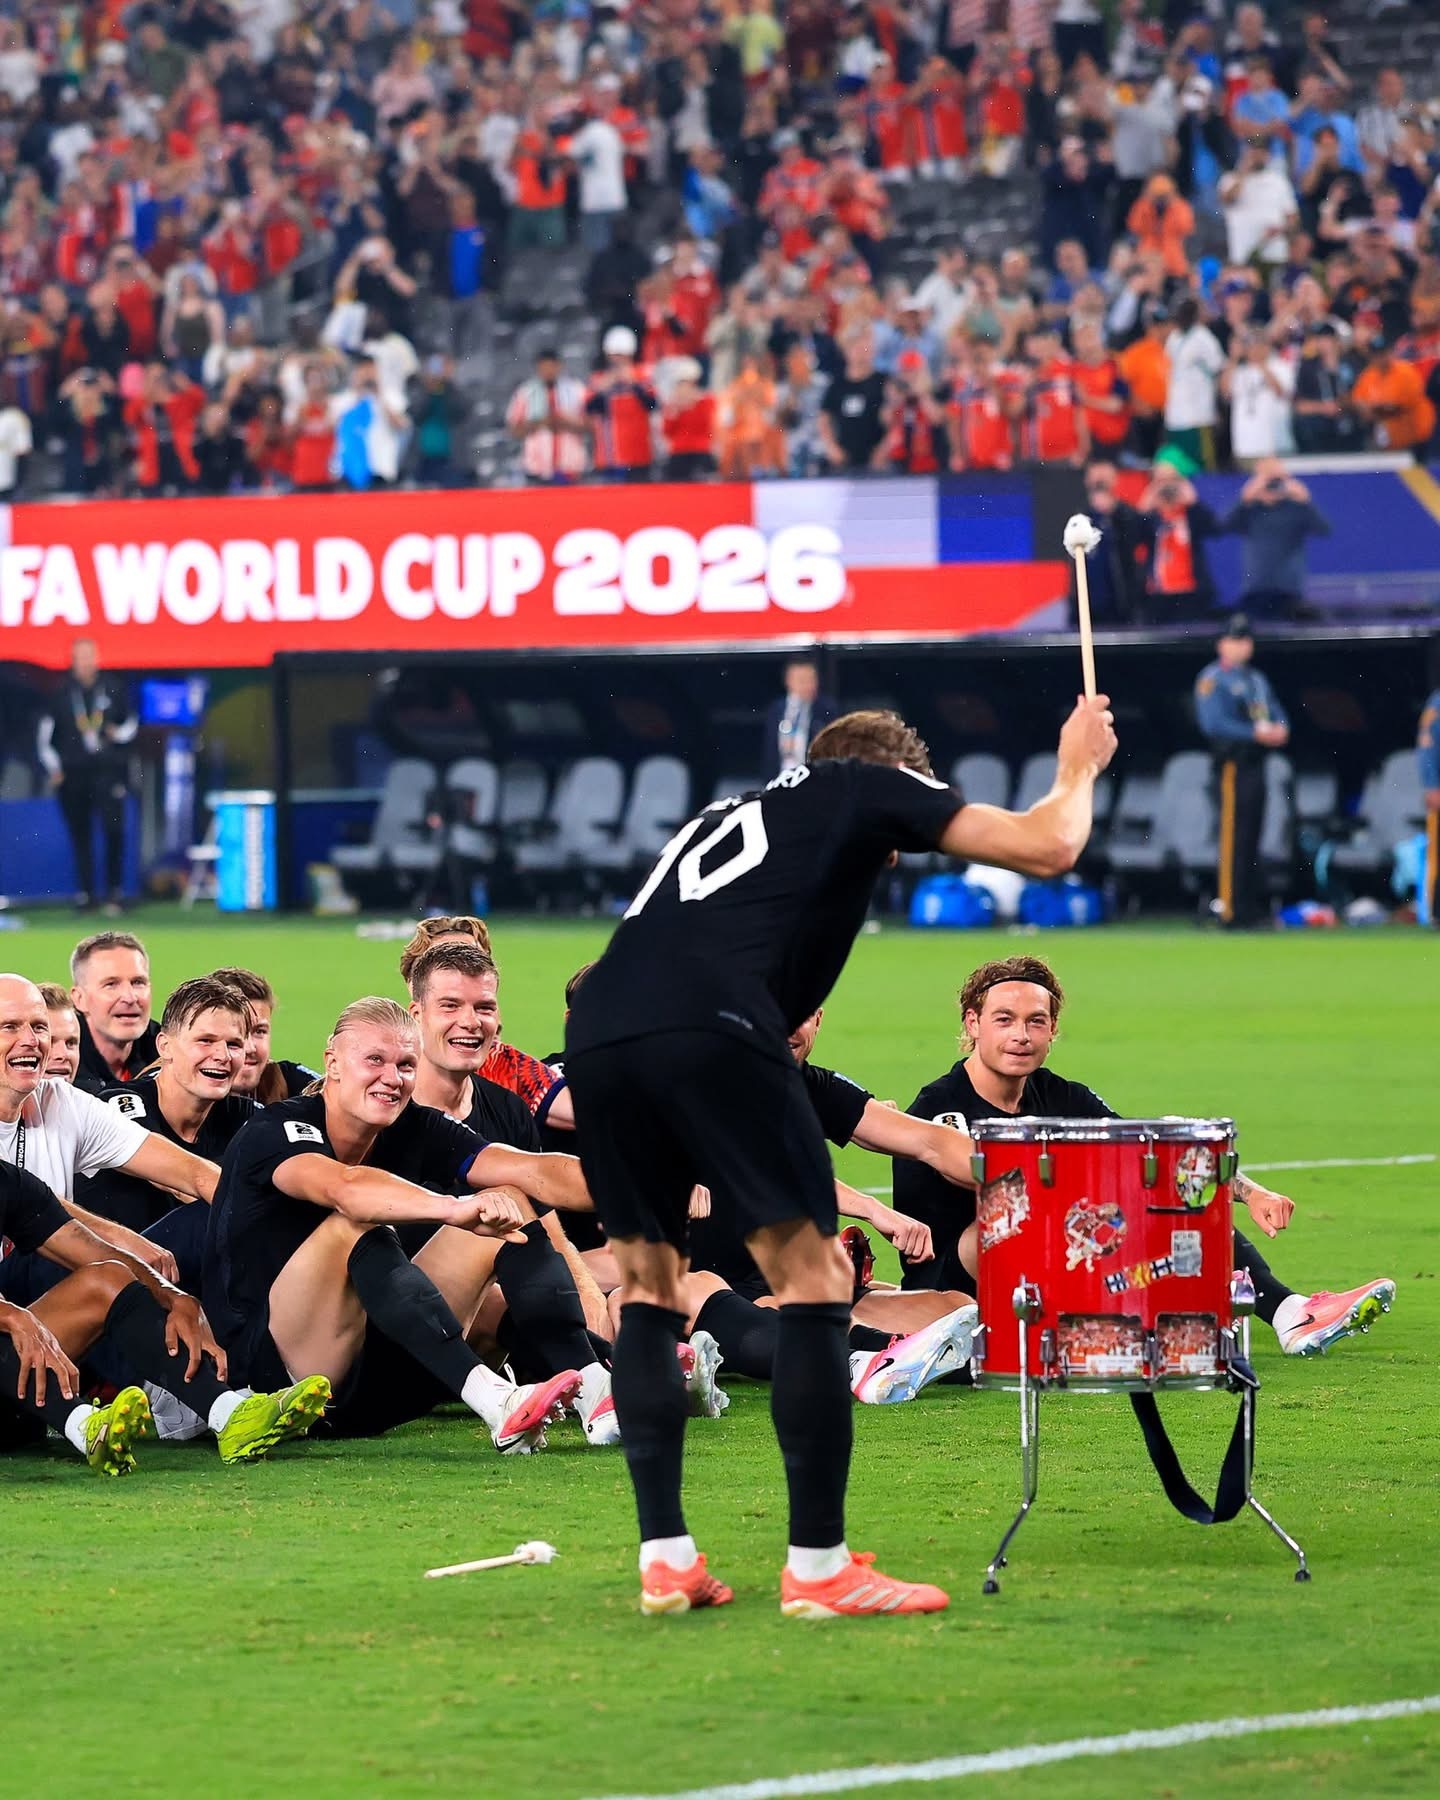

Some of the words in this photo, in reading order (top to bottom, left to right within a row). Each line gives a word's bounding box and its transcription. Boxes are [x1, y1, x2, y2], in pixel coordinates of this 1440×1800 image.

[0, 545, 91, 626] FA
[92, 537, 374, 625] WORLD
[381, 532, 546, 620] CUP
[552, 523, 847, 615] 2026
[623, 799, 769, 920] 10
[17, 1142, 25, 1168] WORLD
